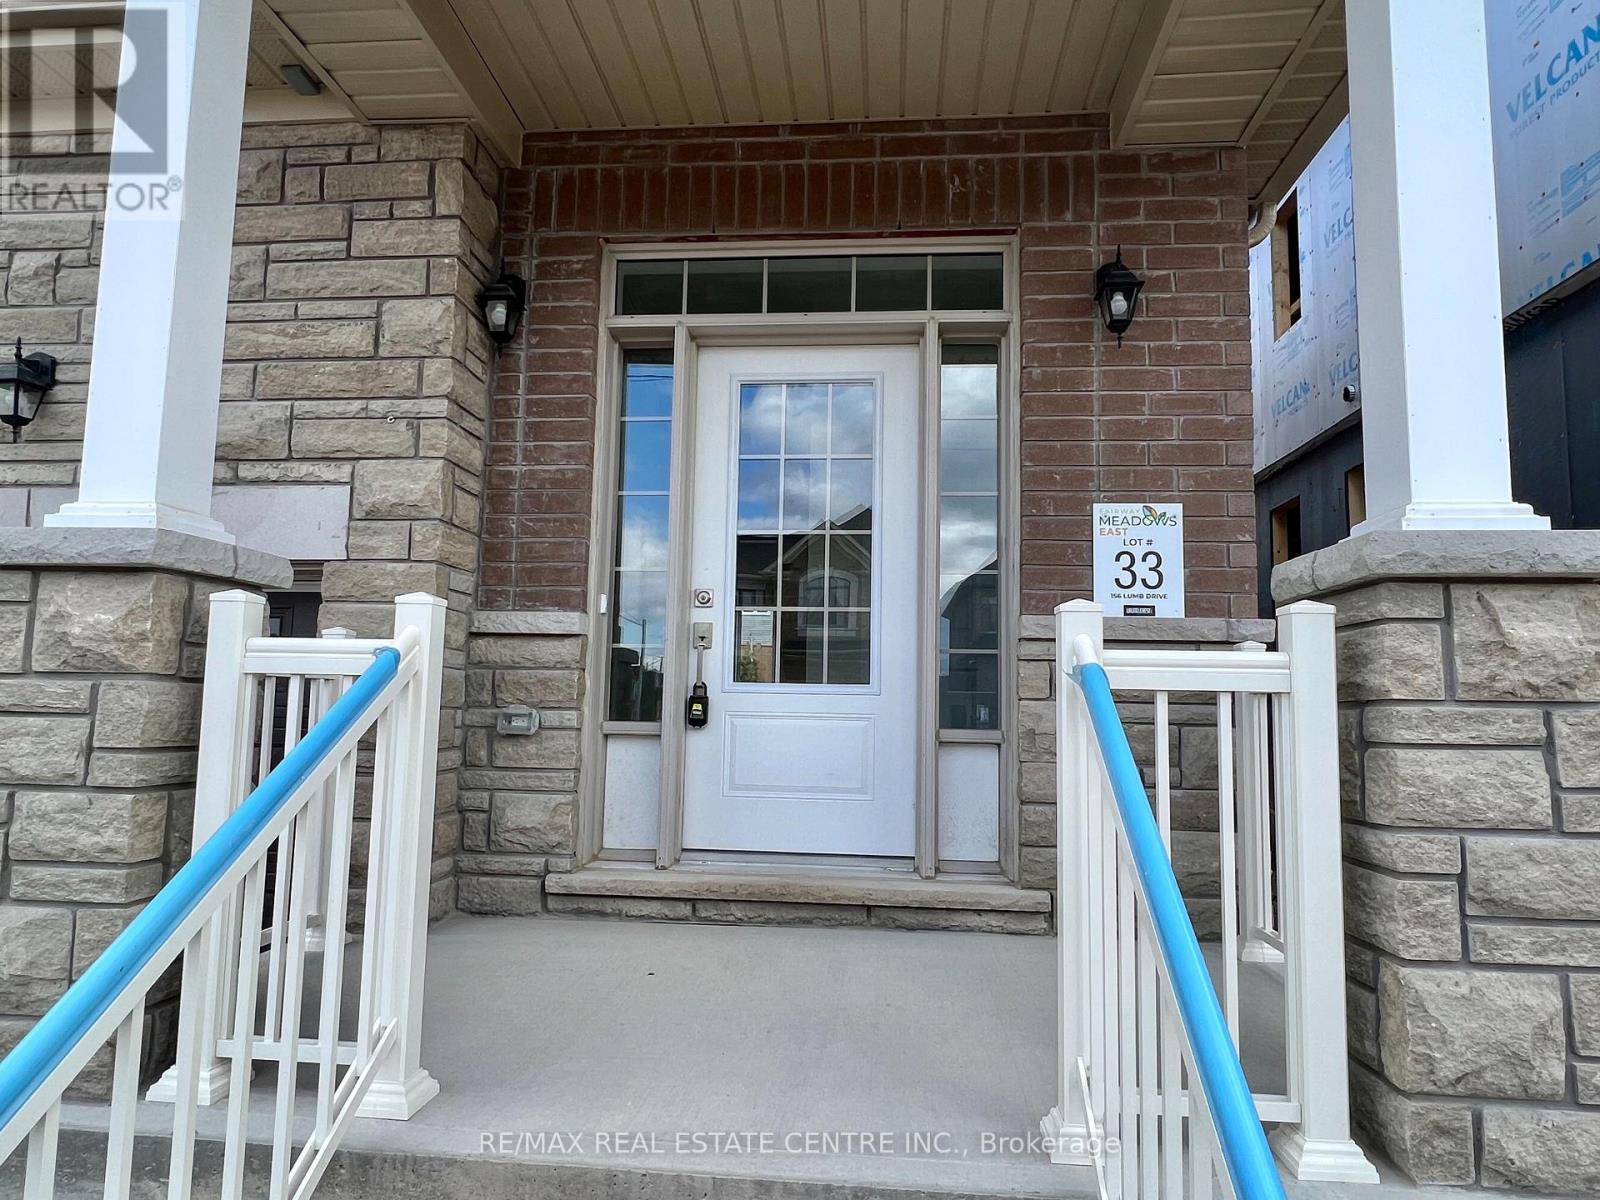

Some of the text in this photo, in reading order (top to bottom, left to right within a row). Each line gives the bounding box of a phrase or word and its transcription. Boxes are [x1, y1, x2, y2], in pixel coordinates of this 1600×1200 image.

[1099, 514, 1177, 527] MEADOWS
[1099, 527, 1128, 536] EAST
[1123, 538, 1143, 547] LOT
[1114, 550, 1164, 590] 33
